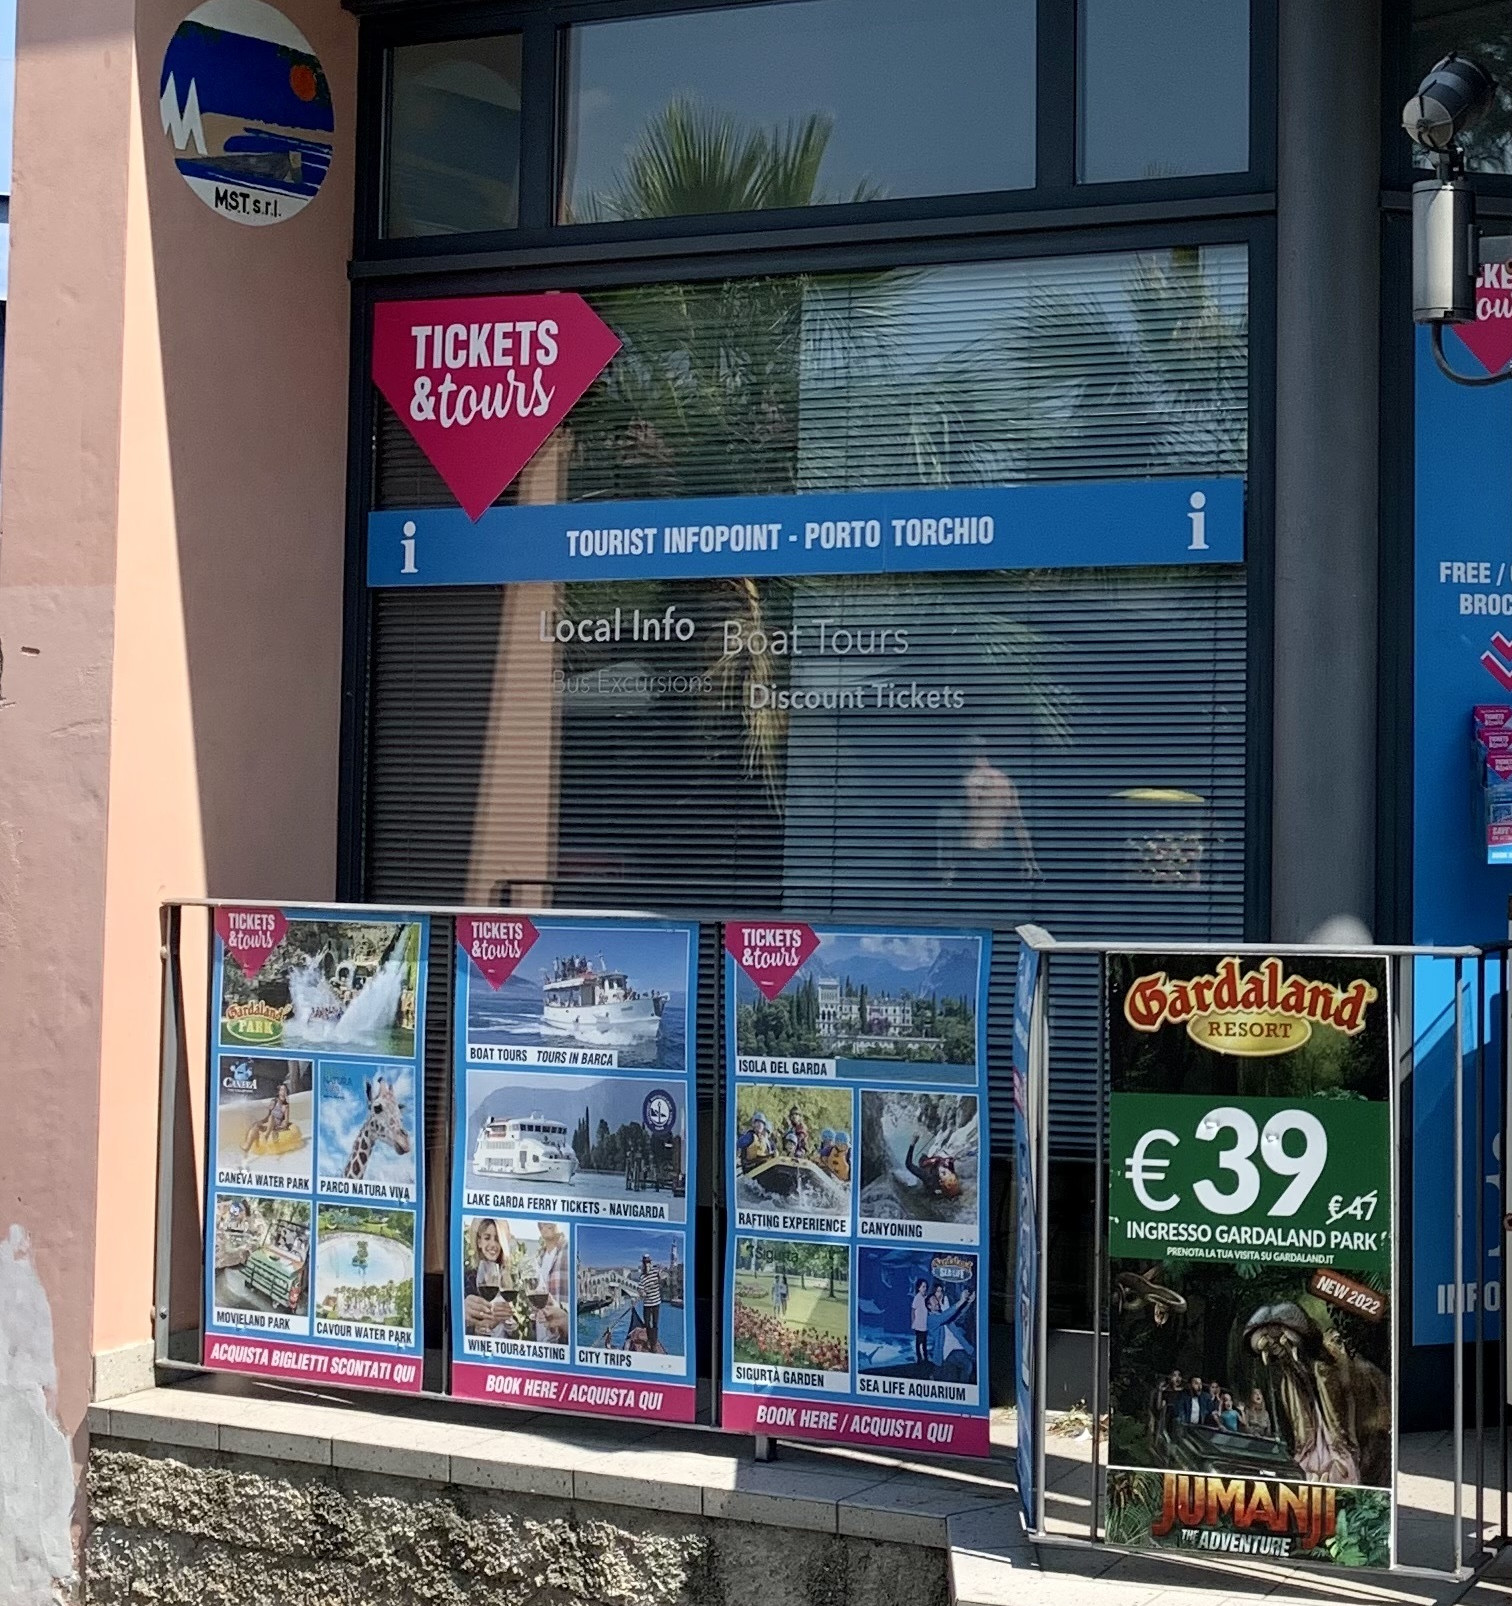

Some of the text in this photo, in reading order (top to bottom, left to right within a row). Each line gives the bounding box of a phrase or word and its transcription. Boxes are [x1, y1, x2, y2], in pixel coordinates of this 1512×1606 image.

[411, 320, 559, 370] TICKETS
[410, 367, 556, 428] &tours
[566, 527, 656, 557] TOURIST
[662, 523, 782, 555] INFOPOINT
[804, 519, 881, 550] PORTO
[890, 515, 995, 547] TORCHIO
[1440, 561, 1505, 586] FREE /
[539, 605, 695, 643] Local Info
[722, 618, 909, 656] Boat Tours
[552, 669, 713, 694] Bus Excursions
[750, 681, 965, 709] Discount Tickets
[228, 913, 275, 930] TICKETS
[471, 922, 523, 940] TICKETS
[228, 929, 274, 950] &tours
[742, 928, 802, 947] TICKETS
[471, 939, 523, 961] &tours
[742, 945, 801, 969] &tours
[1126, 957, 1370, 1033] Gardaland
[238, 1019, 273, 1035] PARK
[1208, 1021, 1292, 1038] RESORT
[470, 1047, 614, 1066] BOAT TOURS TOURS IN BARCA
[738, 1059, 827, 1076] ISOLA DEL GARDA
[218, 1171, 310, 1190] CANEVA WATER PARK
[320, 1180, 411, 1200] PARCO NATURA VIVA
[467, 1193, 665, 1219] LAKE GARDA FERRY TICKETS NAVIGARDA
[738, 1212, 847, 1233] RAFTING EXPERIENCE
[861, 1221, 923, 1238] CANYONING
[1126, 1220, 1378, 1251] INGRESSO GARDALAND PARK
[1166, 1247, 1335, 1265] PRENOTA LA TUA VISITA SU GARDALAND.IT
[1316, 1275, 1382, 1316] NEW 2022
[1437, 1281, 1500, 1315] INFO
[216, 1311, 291, 1330] MOVIELAND PARK
[316, 1322, 412, 1344] CAVOUR WATER PARK
[468, 1338, 566, 1361] WINE TOUR&TASTING
[579, 1349, 632, 1367] CITY TRIPS
[210, 1343, 416, 1383] ACQUISTA BIGLIETTI SCONTATI QUI
[735, 1365, 825, 1387] SIGURTÀ GARDEN
[485, 1374, 664, 1411] BOOK HERE / ACQUISTA QUI
[859, 1377, 966, 1401] SEA LIFE AQUARIUM
[756, 1405, 954, 1443] BOOK HERE / ACQUISTA QUI
[1152, 1473, 1336, 1548] JUMANJI
[1181, 1528, 1292, 1558] THE ADVENTURE
